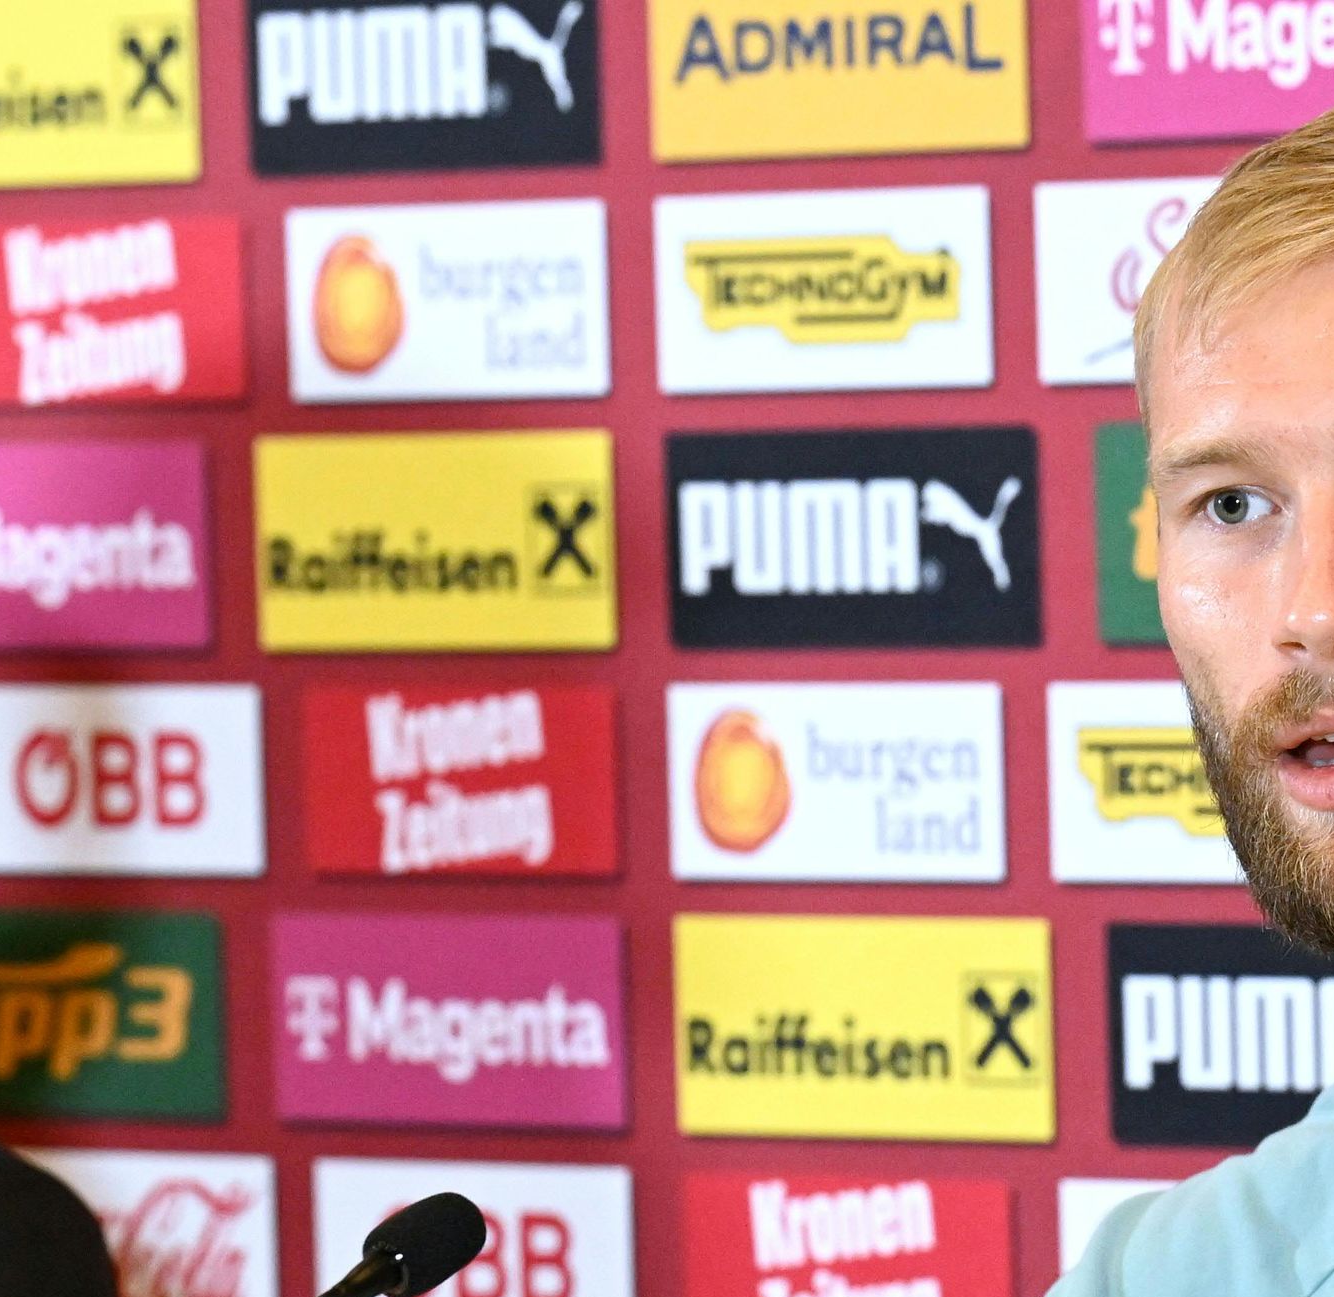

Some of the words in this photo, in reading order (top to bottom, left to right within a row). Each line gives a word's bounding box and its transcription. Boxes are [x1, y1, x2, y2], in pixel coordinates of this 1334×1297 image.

[256, 2, 489, 126] PUMA
[675, 2, 1005, 84] ADMIRAL
[4, 219, 178, 316] Kronen
[419, 244, 585, 306] burgen
[484, 311, 587, 372] land
[268, 528, 518, 597] Raiffeisen
[678, 478, 919, 595] PUMA
[16, 727, 207, 830] ÖBB
[366, 690, 545, 783] Kronen
[807, 718, 979, 784] burgen
[374, 776, 555, 875] Zeitung
[874, 798, 982, 856] land
[348, 976, 610, 1084] Magenta
[686, 1013, 950, 1081] Raiffeisen
[748, 1179, 936, 1270] Kronen
